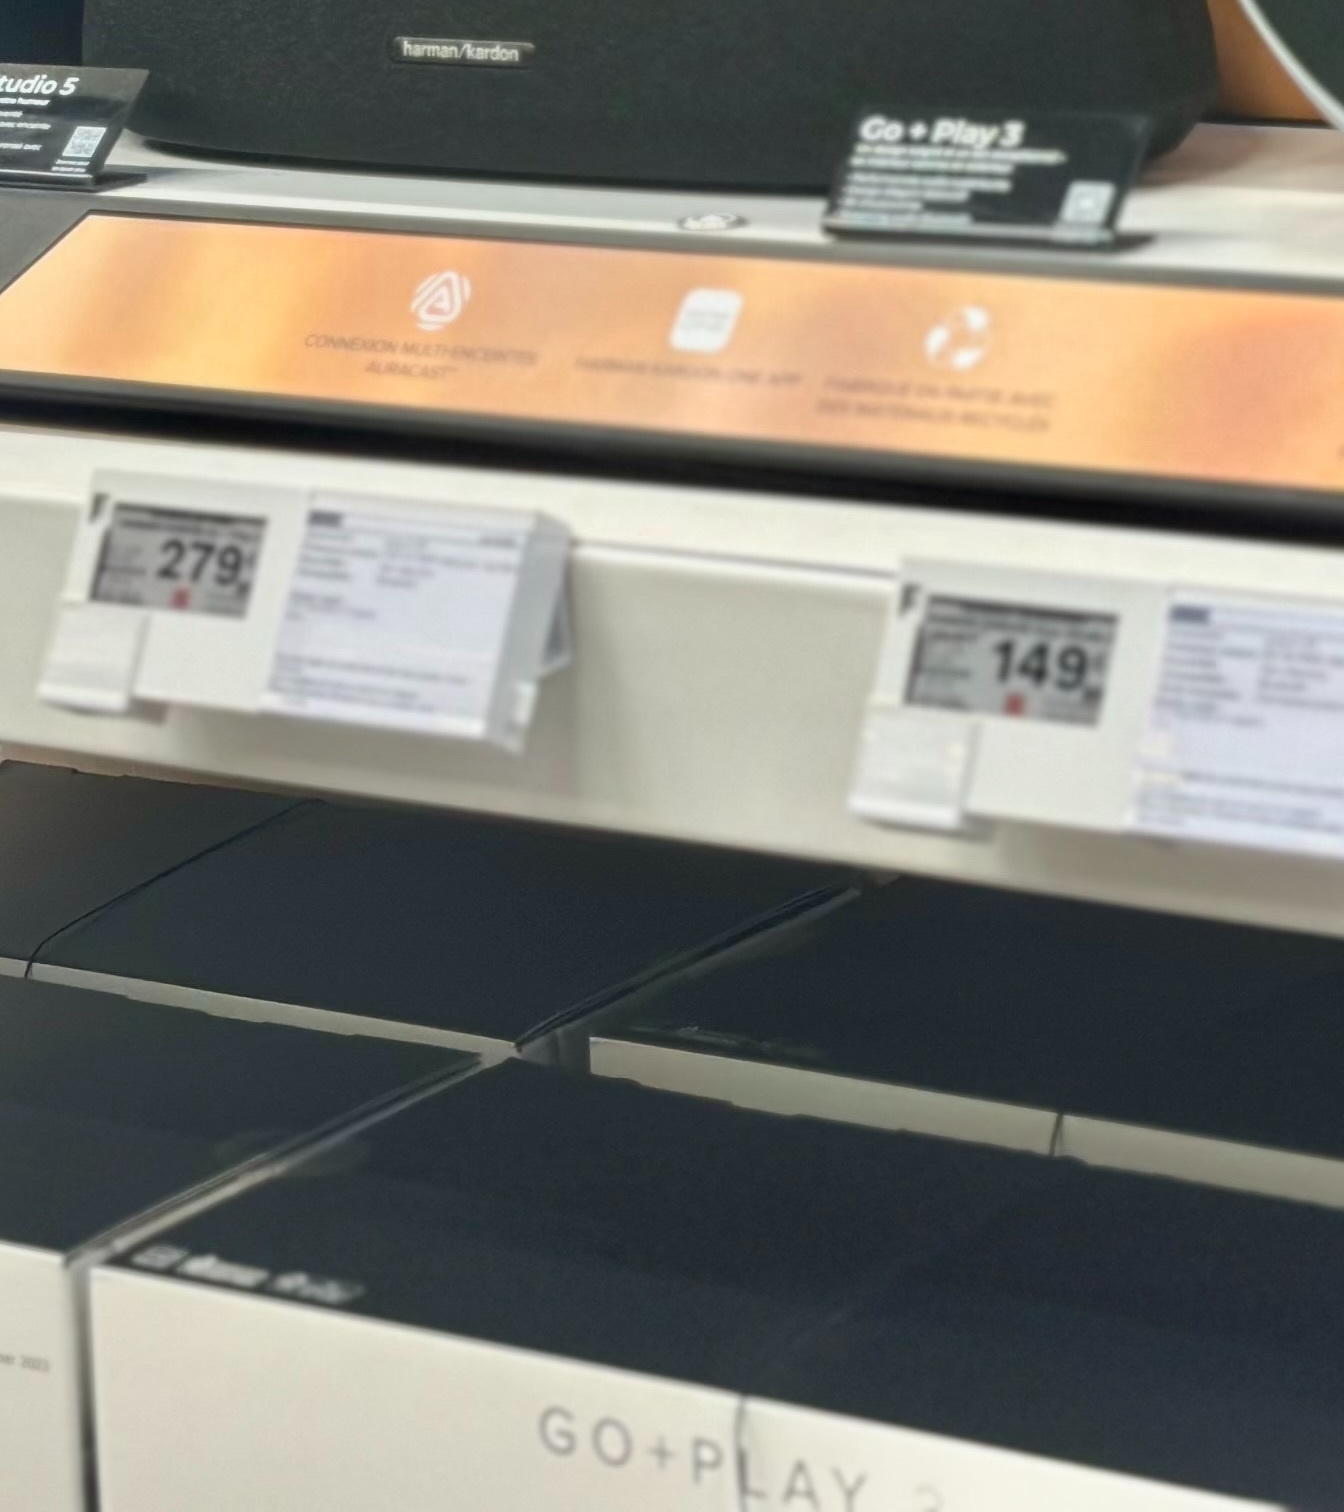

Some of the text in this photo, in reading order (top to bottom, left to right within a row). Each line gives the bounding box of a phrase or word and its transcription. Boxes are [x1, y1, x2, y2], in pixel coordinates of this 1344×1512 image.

[59, 77, 80, 95] 5
[860, 115, 904, 142] Go
[930, 117, 999, 150] Play
[156, 538, 243, 586] 279
[992, 640, 1087, 693] 149
